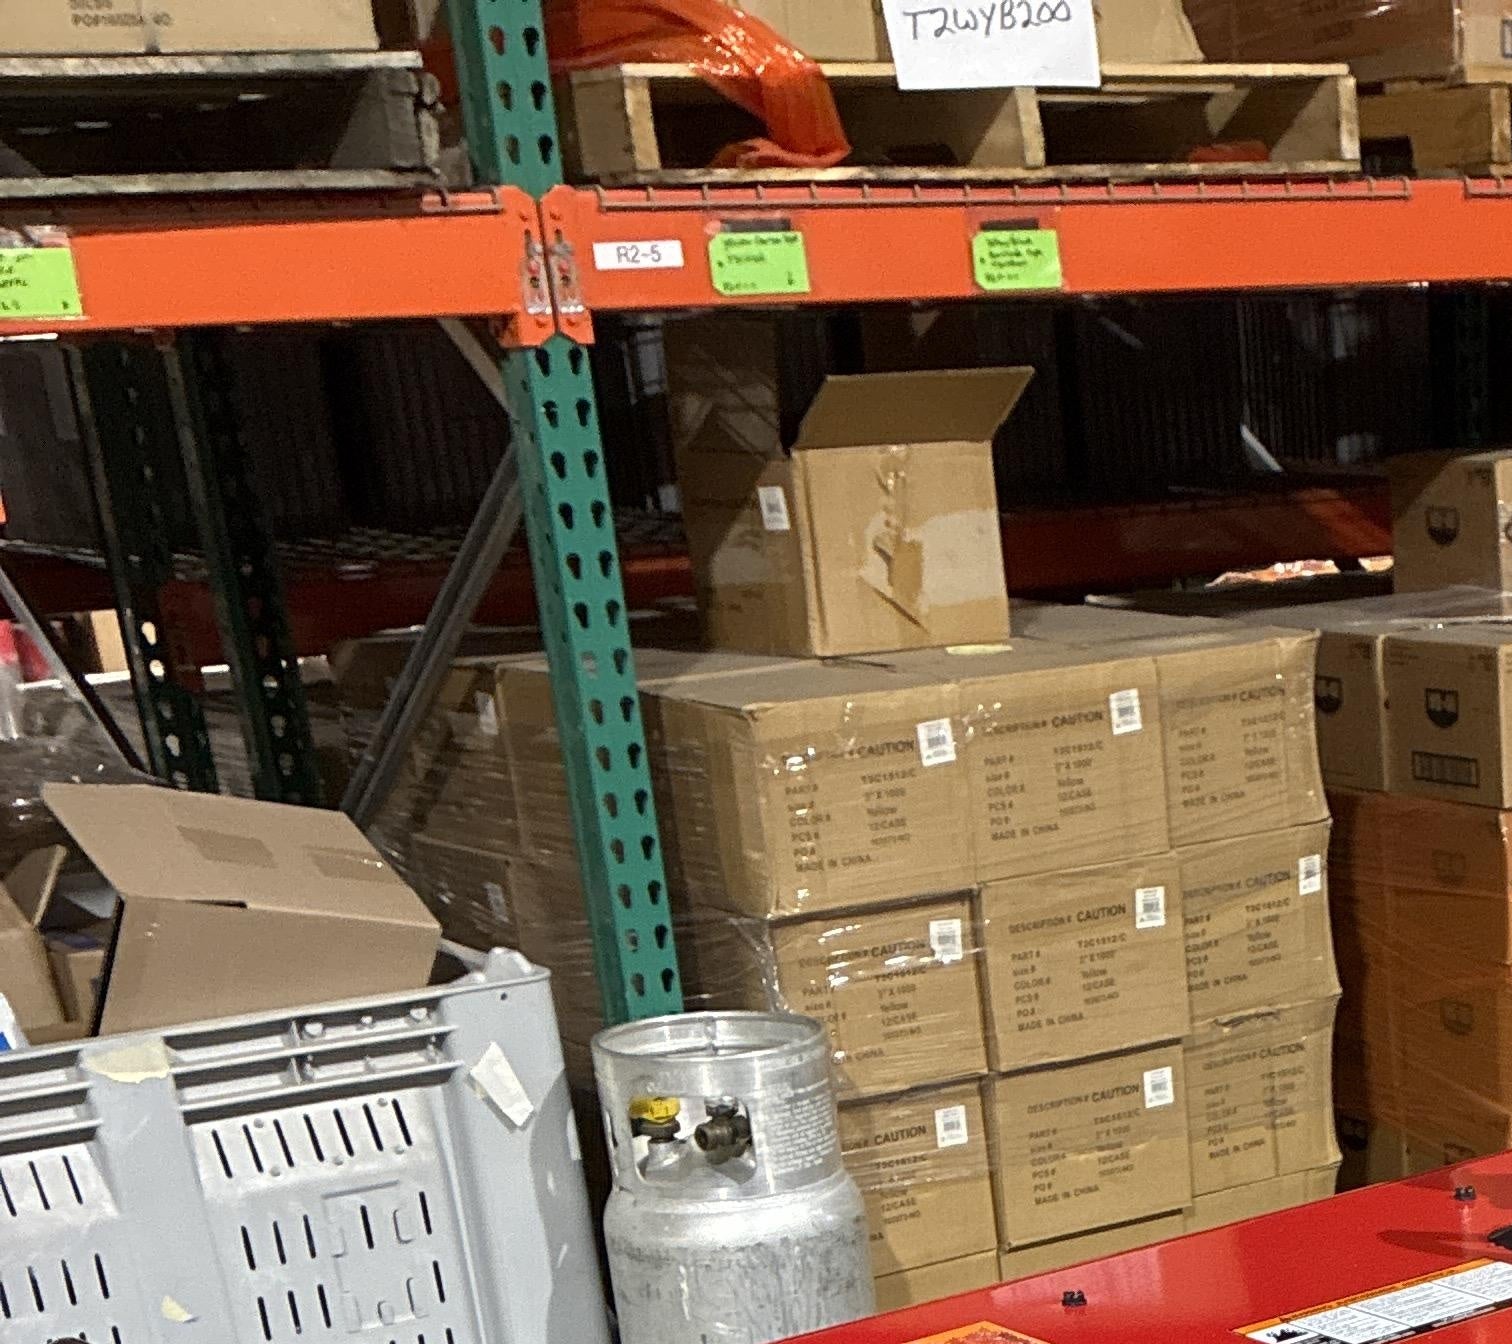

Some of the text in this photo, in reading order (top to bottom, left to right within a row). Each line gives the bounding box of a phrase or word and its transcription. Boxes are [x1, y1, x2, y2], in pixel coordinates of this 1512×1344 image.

[616, 245, 662, 264] R2-5
[1051, 711, 1103, 729] CAUTION
[857, 740, 914, 756] CAUTION
[1009, 903, 1127, 934] DESCRIPTION CAUTION
[871, 938, 926, 958] CAUTION
[1017, 1020, 1043, 1033] MADE
[1058, 1011, 1085, 1025] CHINA
[1027, 1083, 1140, 1114] DESCRIPTION CAUTION
[874, 1125, 927, 1146] CAUTION
[1074, 1184, 1099, 1197] CHINA
